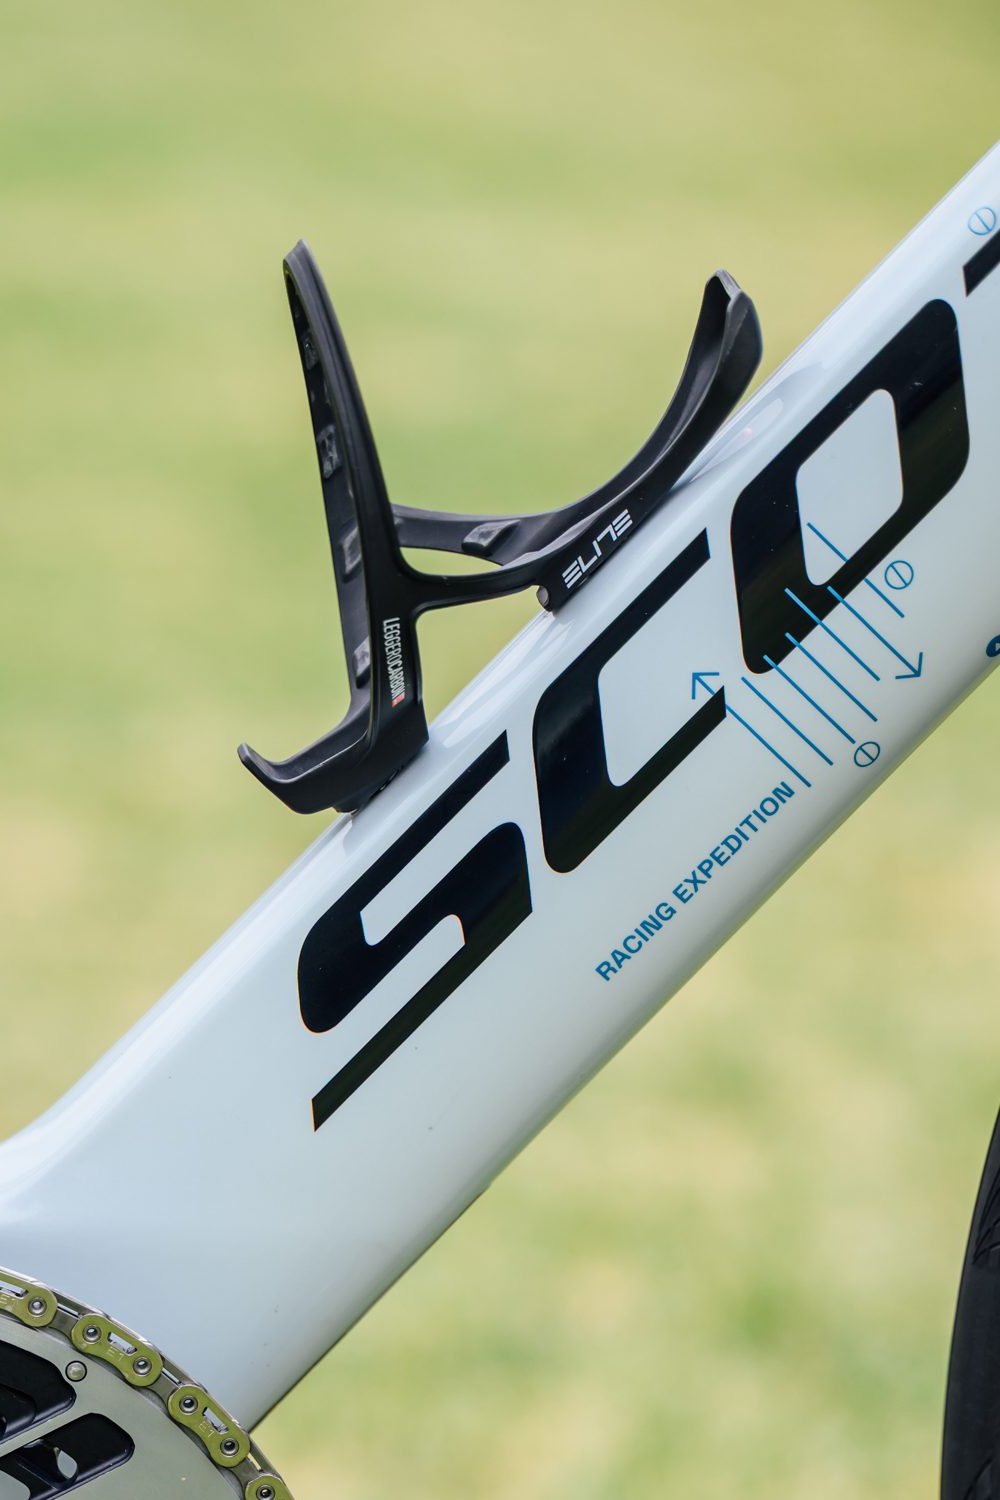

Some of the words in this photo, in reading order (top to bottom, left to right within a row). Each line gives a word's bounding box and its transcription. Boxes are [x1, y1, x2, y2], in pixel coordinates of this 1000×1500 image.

[562, 509, 633, 590] ELITE
[297, 228, 1000, 1133] SCO
[595, 902, 677, 982] RACING
[672, 781, 795, 904] EXPEDITION
